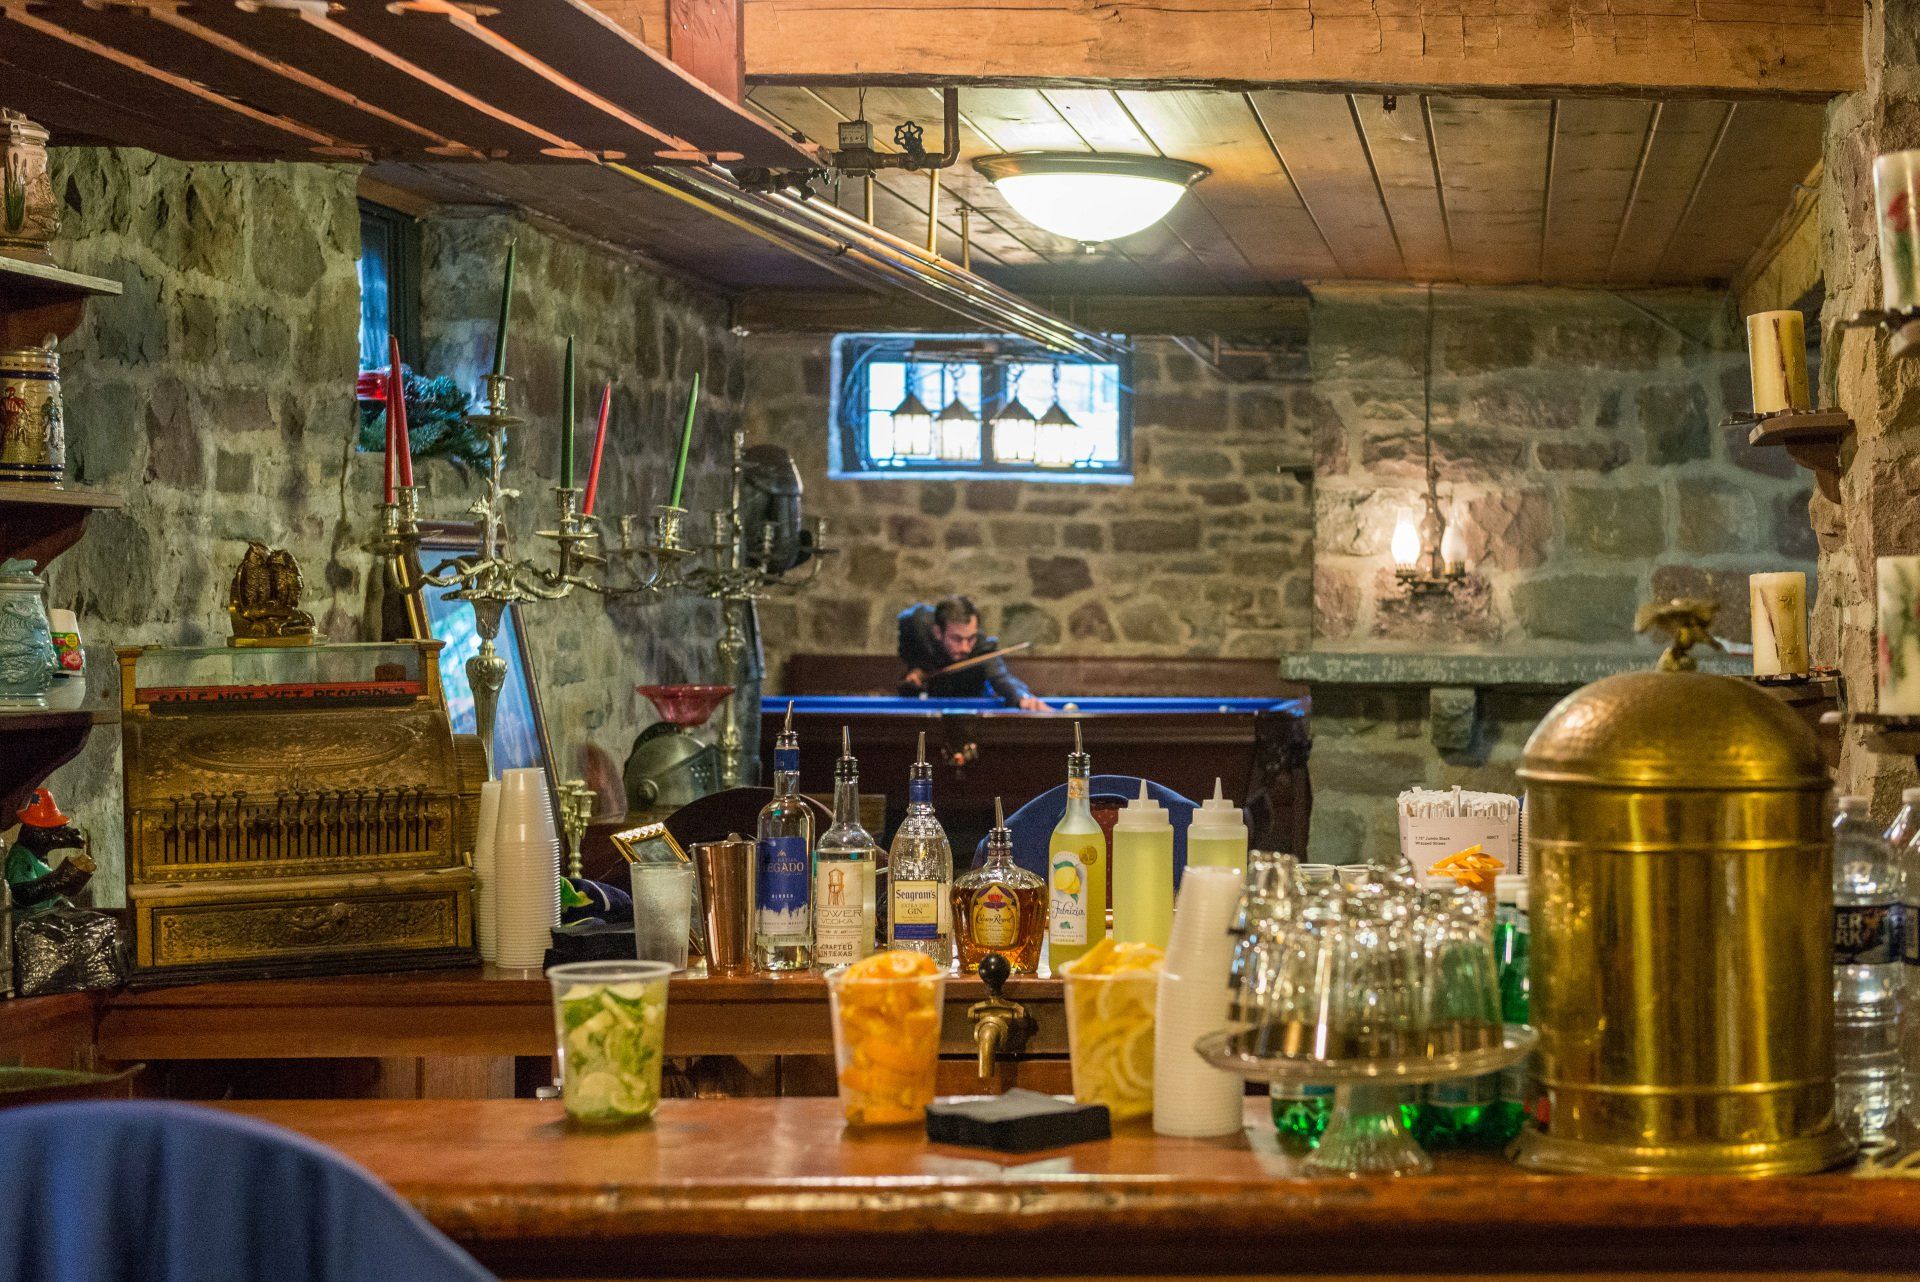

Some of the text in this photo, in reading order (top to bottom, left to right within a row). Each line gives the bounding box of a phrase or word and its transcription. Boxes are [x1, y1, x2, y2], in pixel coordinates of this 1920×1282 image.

[217, 691, 255, 701] NOT
[895, 889, 937, 901] Seagram's
[907, 907, 923, 915] GIN
[820, 943, 853, 951] CRAFTED
